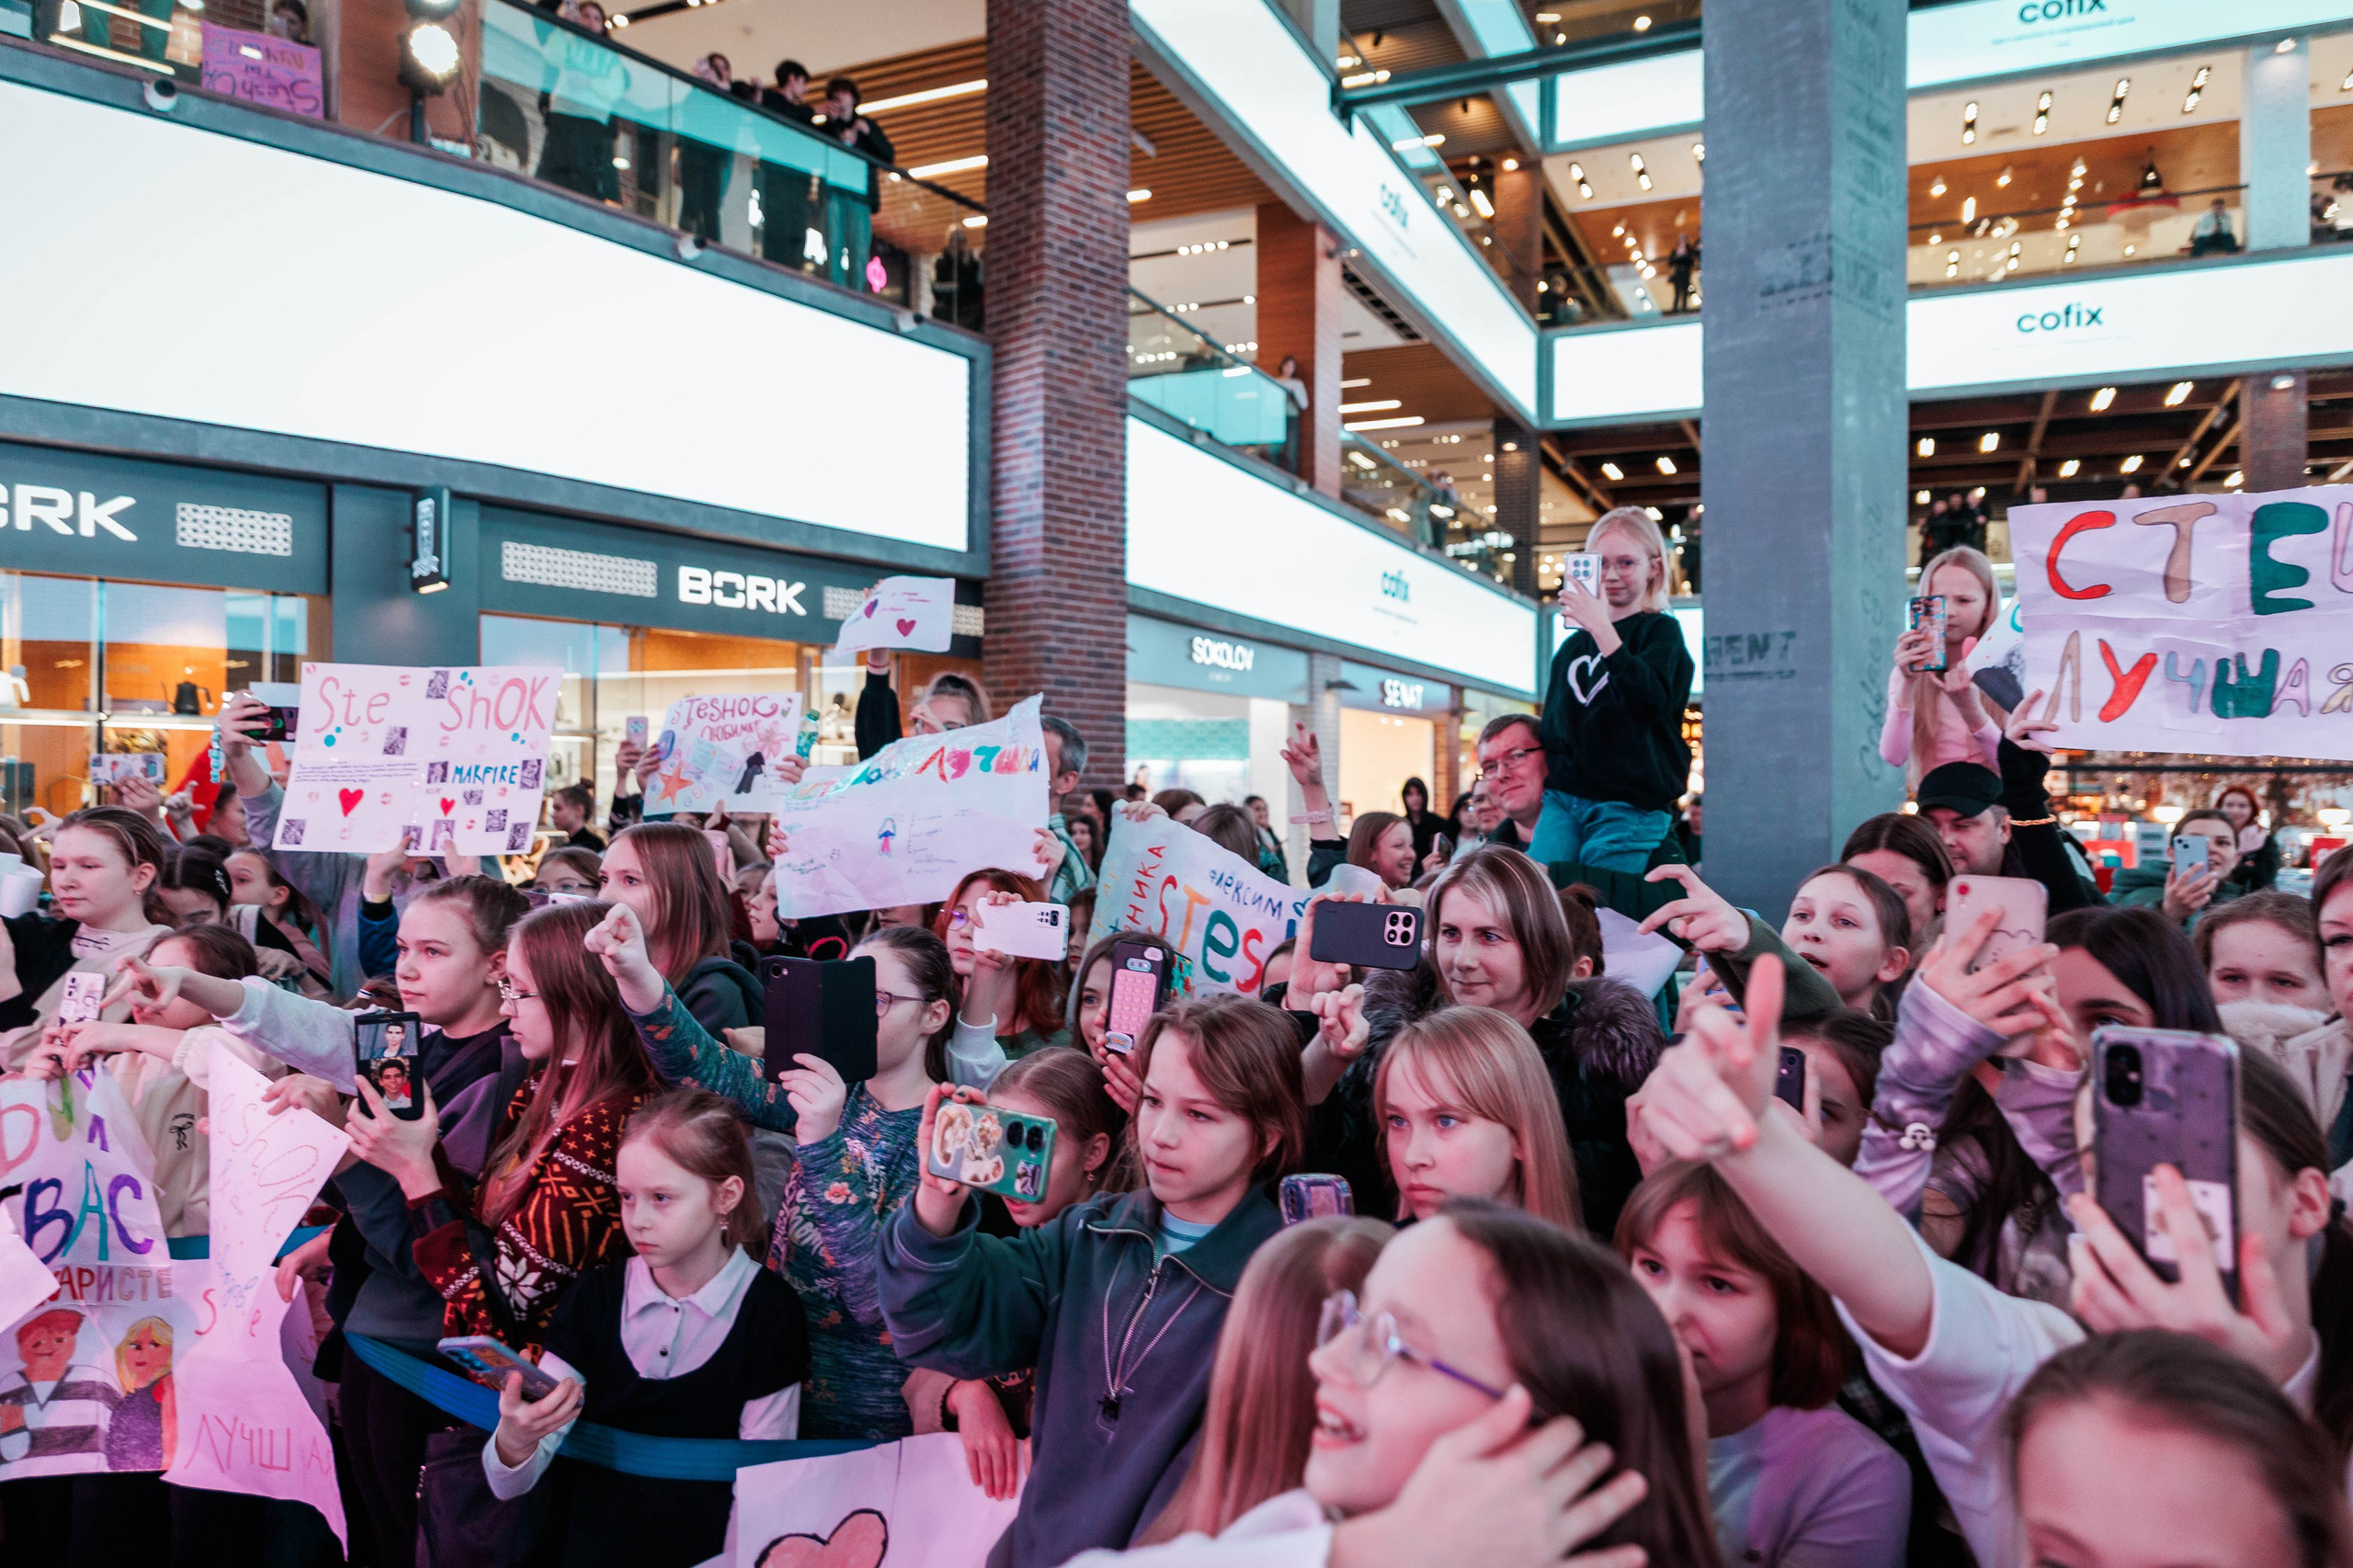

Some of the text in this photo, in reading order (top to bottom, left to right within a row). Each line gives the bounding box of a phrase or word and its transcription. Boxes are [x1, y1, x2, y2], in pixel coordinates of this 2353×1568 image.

[2017, 301, 2104, 334] cofix
[0, 482, 138, 542] RK
[677, 565, 808, 617] BORK
[1191, 636, 1255, 672] SOKOLOV
[1383, 677, 1426, 710] SENAT
[24, 1159, 154, 1265] ВАС
[48, 1266, 173, 1302] АРИСТЕ
